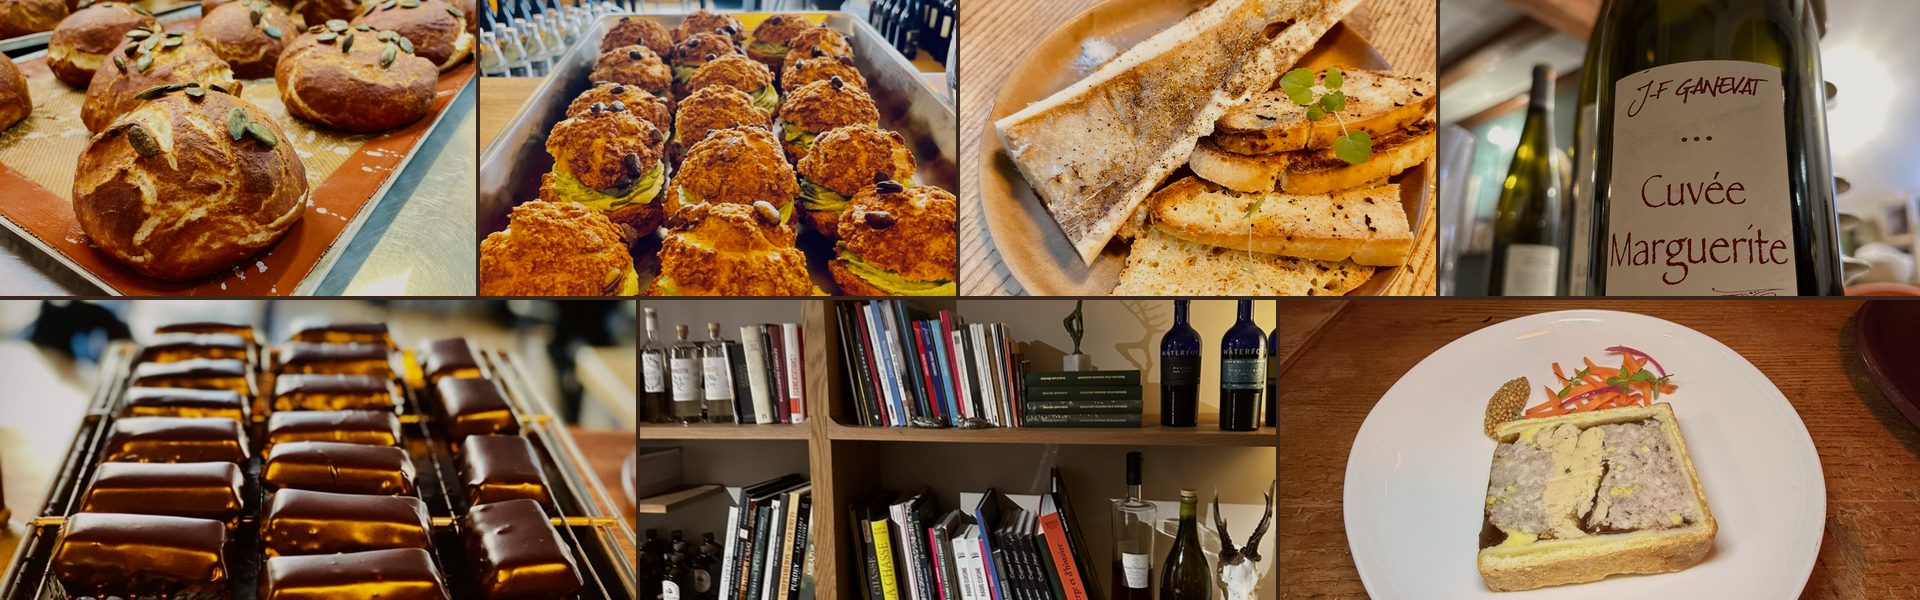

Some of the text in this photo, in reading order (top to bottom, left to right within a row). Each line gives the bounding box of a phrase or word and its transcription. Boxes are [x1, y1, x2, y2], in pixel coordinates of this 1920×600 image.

[1675, 76, 1768, 104] GANEVAT
[1641, 171, 1747, 208] Cuvée
[1610, 224, 1789, 285] Marguerite
[868, 556, 880, 595] CHASSE
[878, 542, 894, 586] CHASSE
[1058, 543, 1073, 576] d'histoire
[790, 563, 800, 592] PURDEY
[1070, 576, 1076, 586] et
